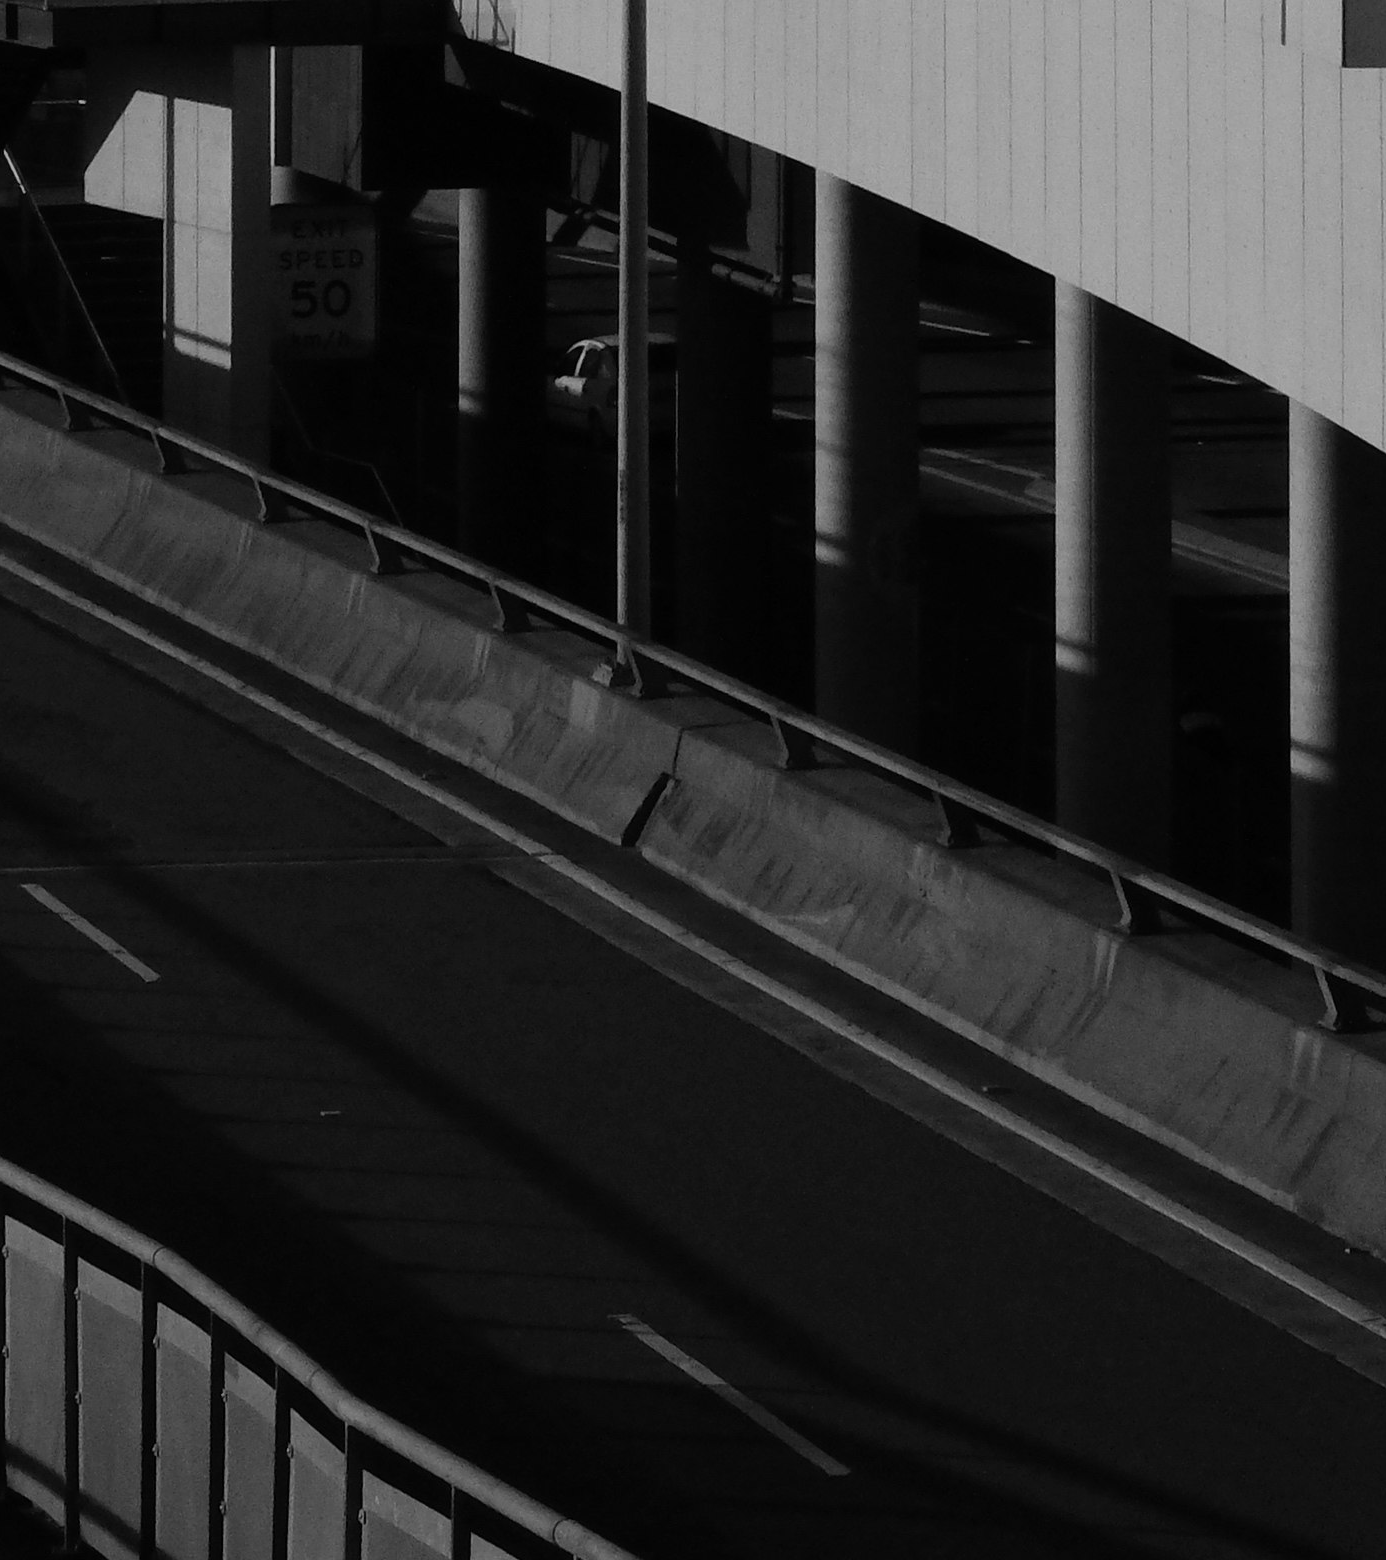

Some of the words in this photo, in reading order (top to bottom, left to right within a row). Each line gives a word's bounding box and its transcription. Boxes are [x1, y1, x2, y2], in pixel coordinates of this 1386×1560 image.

[292, 217, 348, 239] EXIT
[279, 248, 364, 270] SPEED
[291, 278, 352, 318] 50
